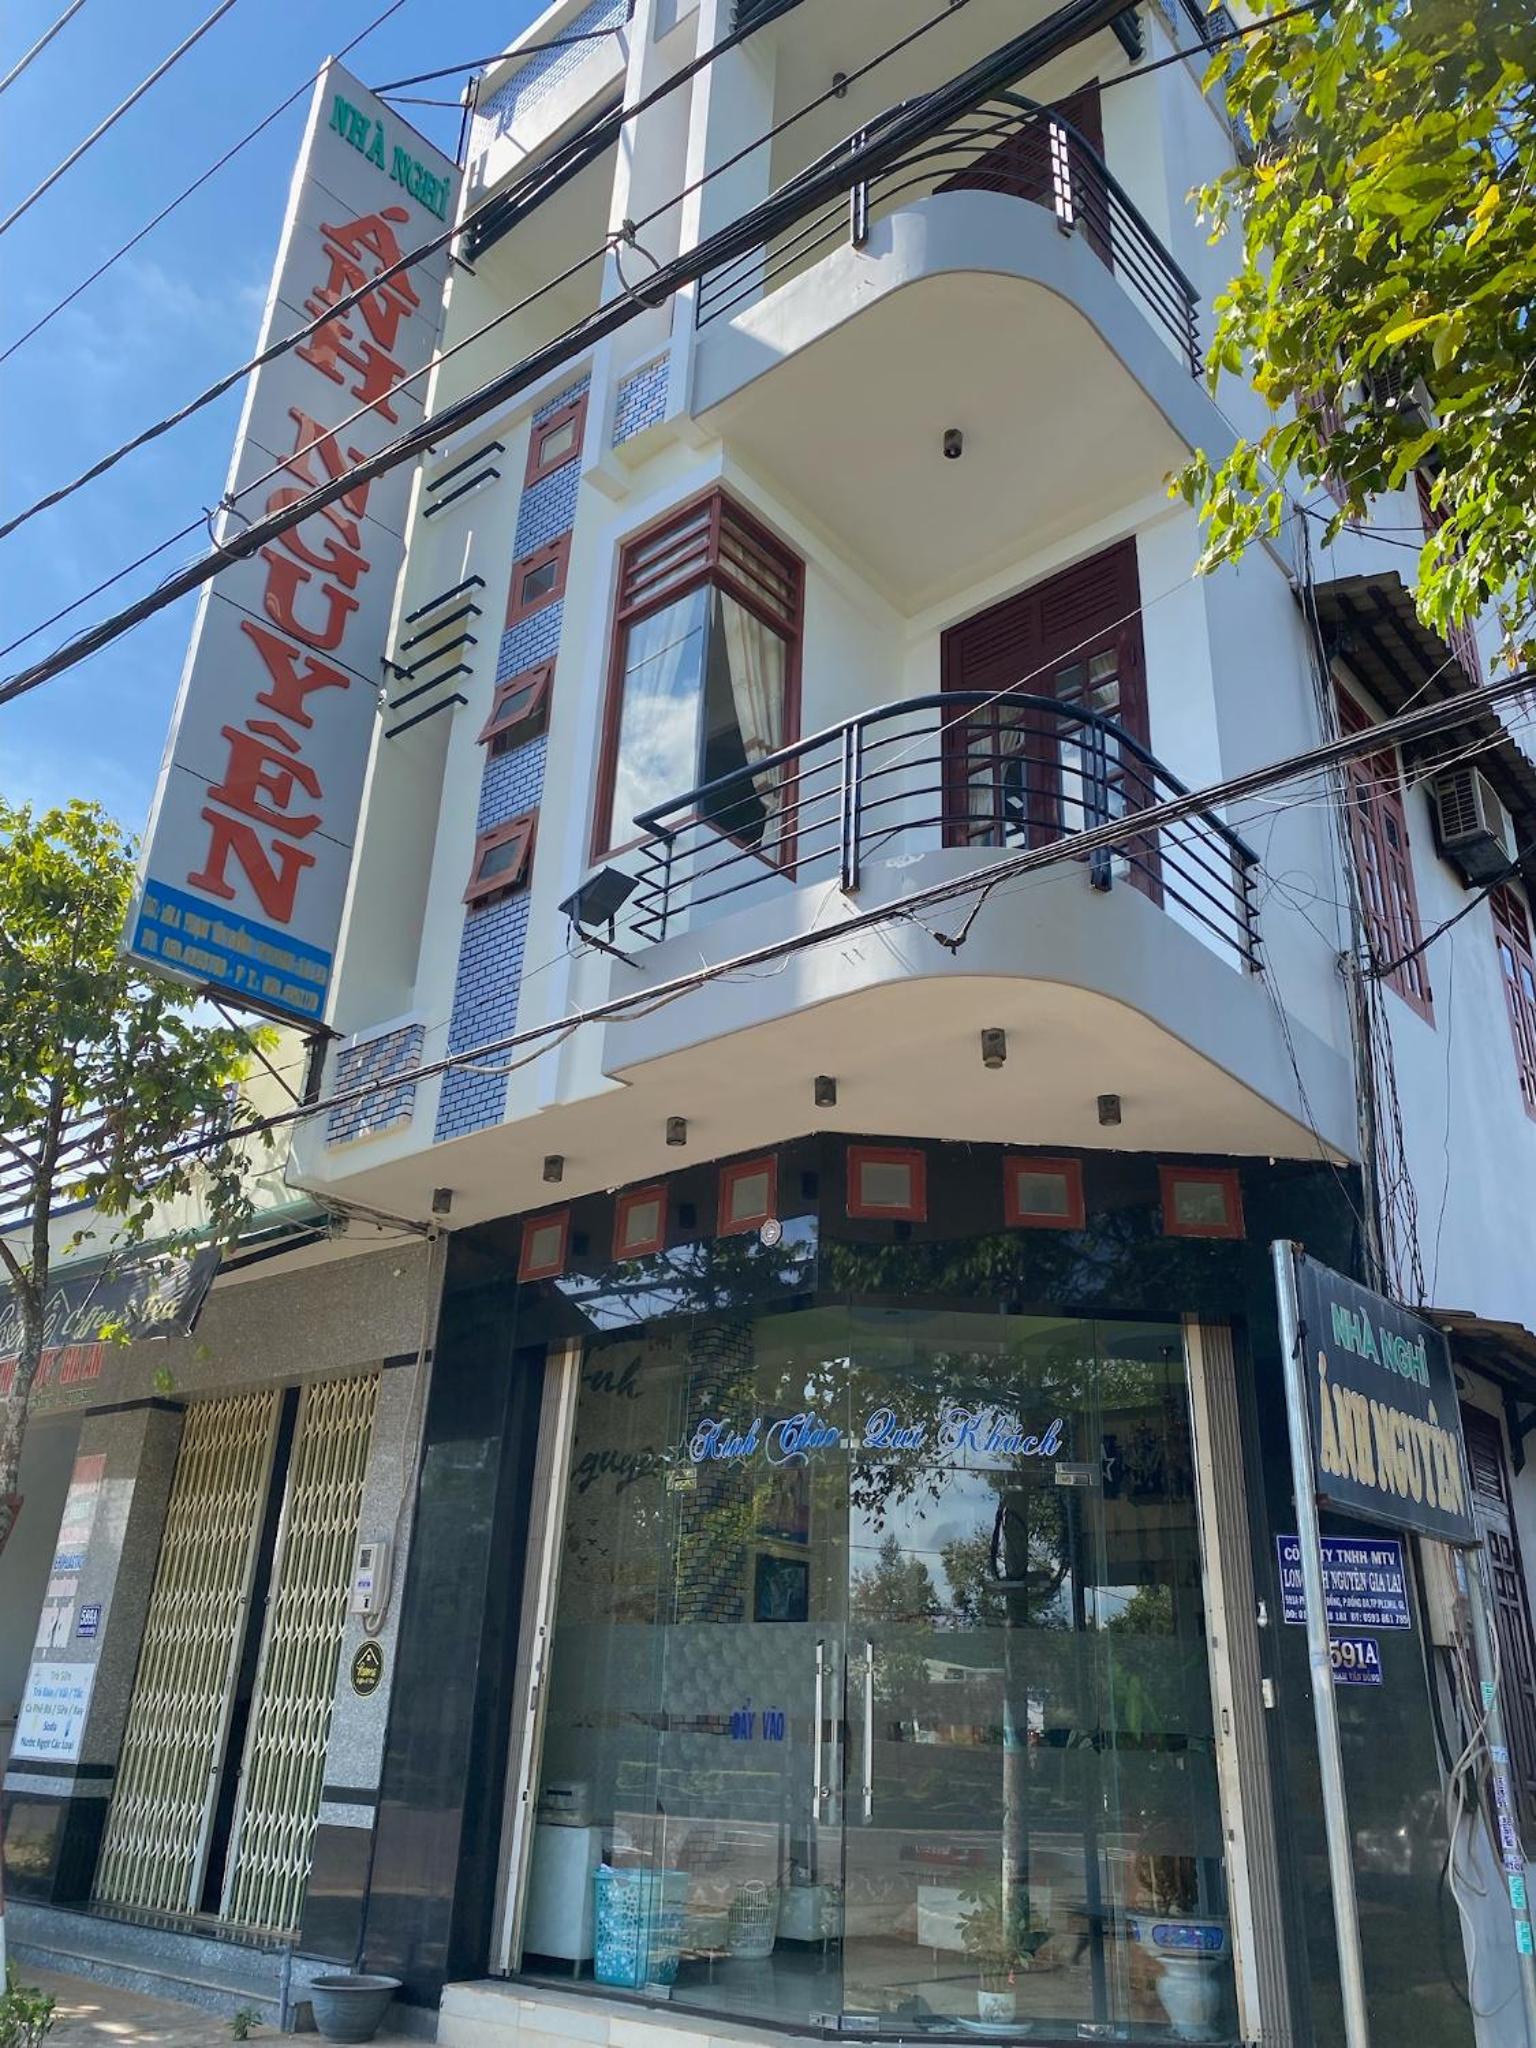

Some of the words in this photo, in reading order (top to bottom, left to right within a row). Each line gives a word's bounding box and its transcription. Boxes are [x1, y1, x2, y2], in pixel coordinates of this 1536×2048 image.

[329, 95, 385, 171] NHÀ
[187, 407, 383, 923] NGUYÊN
[1330, 1302, 1381, 1365] NHÀ
[937, 1408, 1063, 1456] Khách
[1283, 1569, 1301, 1588] LON
[1369, 1572, 1385, 1592] GIA
[1386, 1573, 1402, 1593] LAI
[1337, 1550, 1368, 1565] TNHH
[1371, 1551, 1395, 1565] MTV
[1330, 1640, 1377, 1669] 591A
